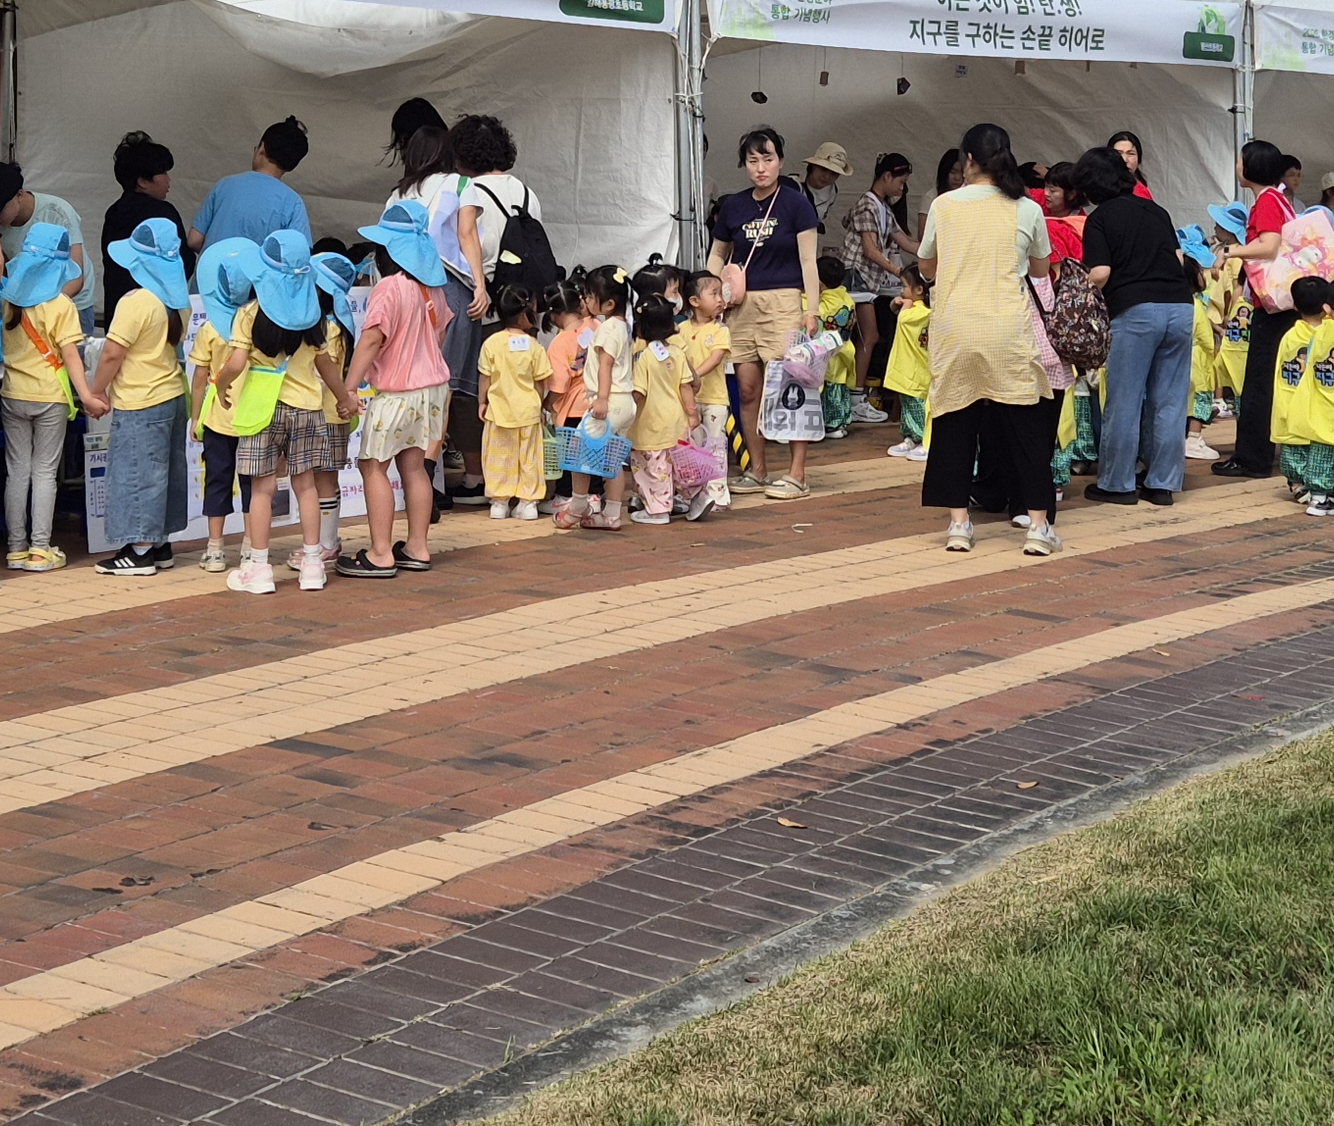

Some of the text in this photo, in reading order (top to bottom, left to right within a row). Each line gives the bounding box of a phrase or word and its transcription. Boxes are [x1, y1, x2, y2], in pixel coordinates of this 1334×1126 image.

[770, 3, 831, 24] 통합 기념행사
[909, 18, 1106, 53] 지구를 구하는 손끝 히어로
